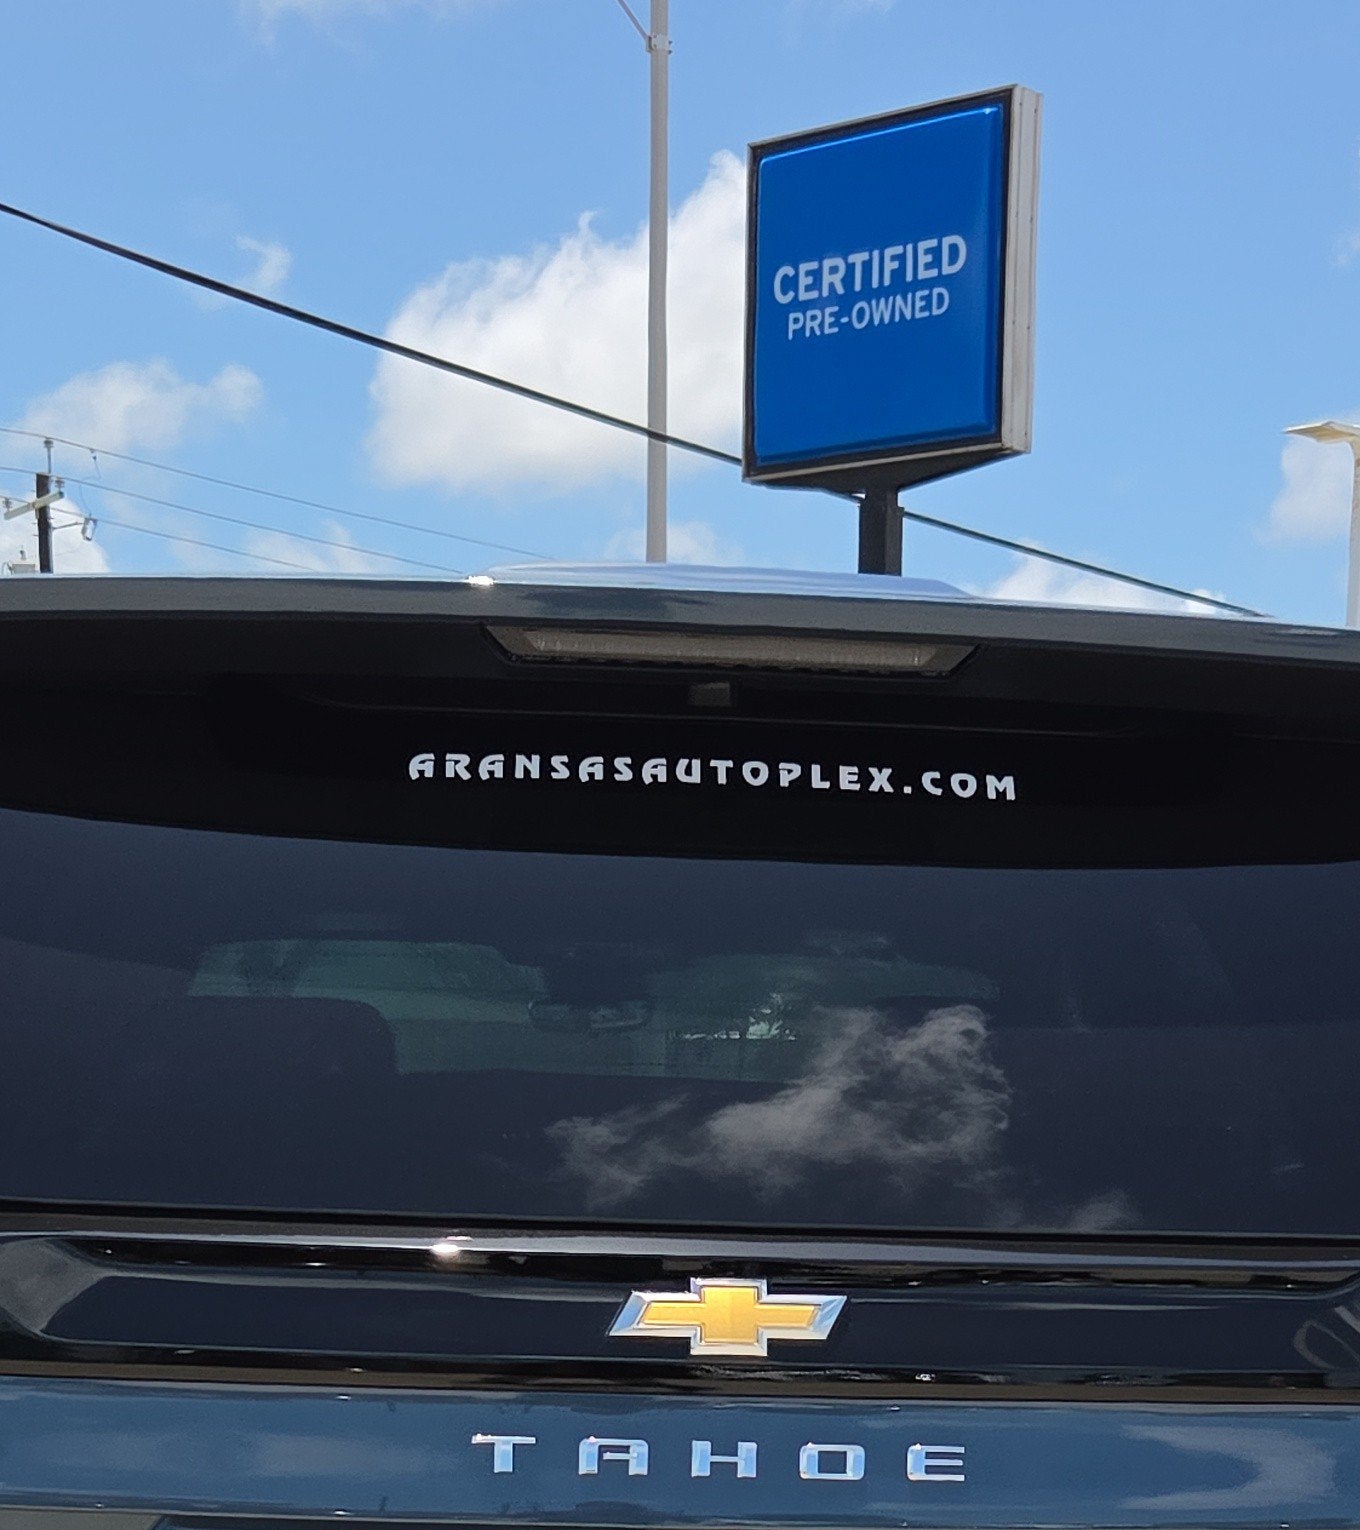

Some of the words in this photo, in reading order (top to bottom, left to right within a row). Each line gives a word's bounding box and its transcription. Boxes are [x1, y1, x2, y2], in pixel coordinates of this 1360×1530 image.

[773, 235, 967, 304] CERTIFIED
[788, 287, 950, 340] PRE-OWNED
[408, 752, 1016, 801] ARANSASAUTOPLEX.COM
[471, 1433, 965, 1482] TAHOE
